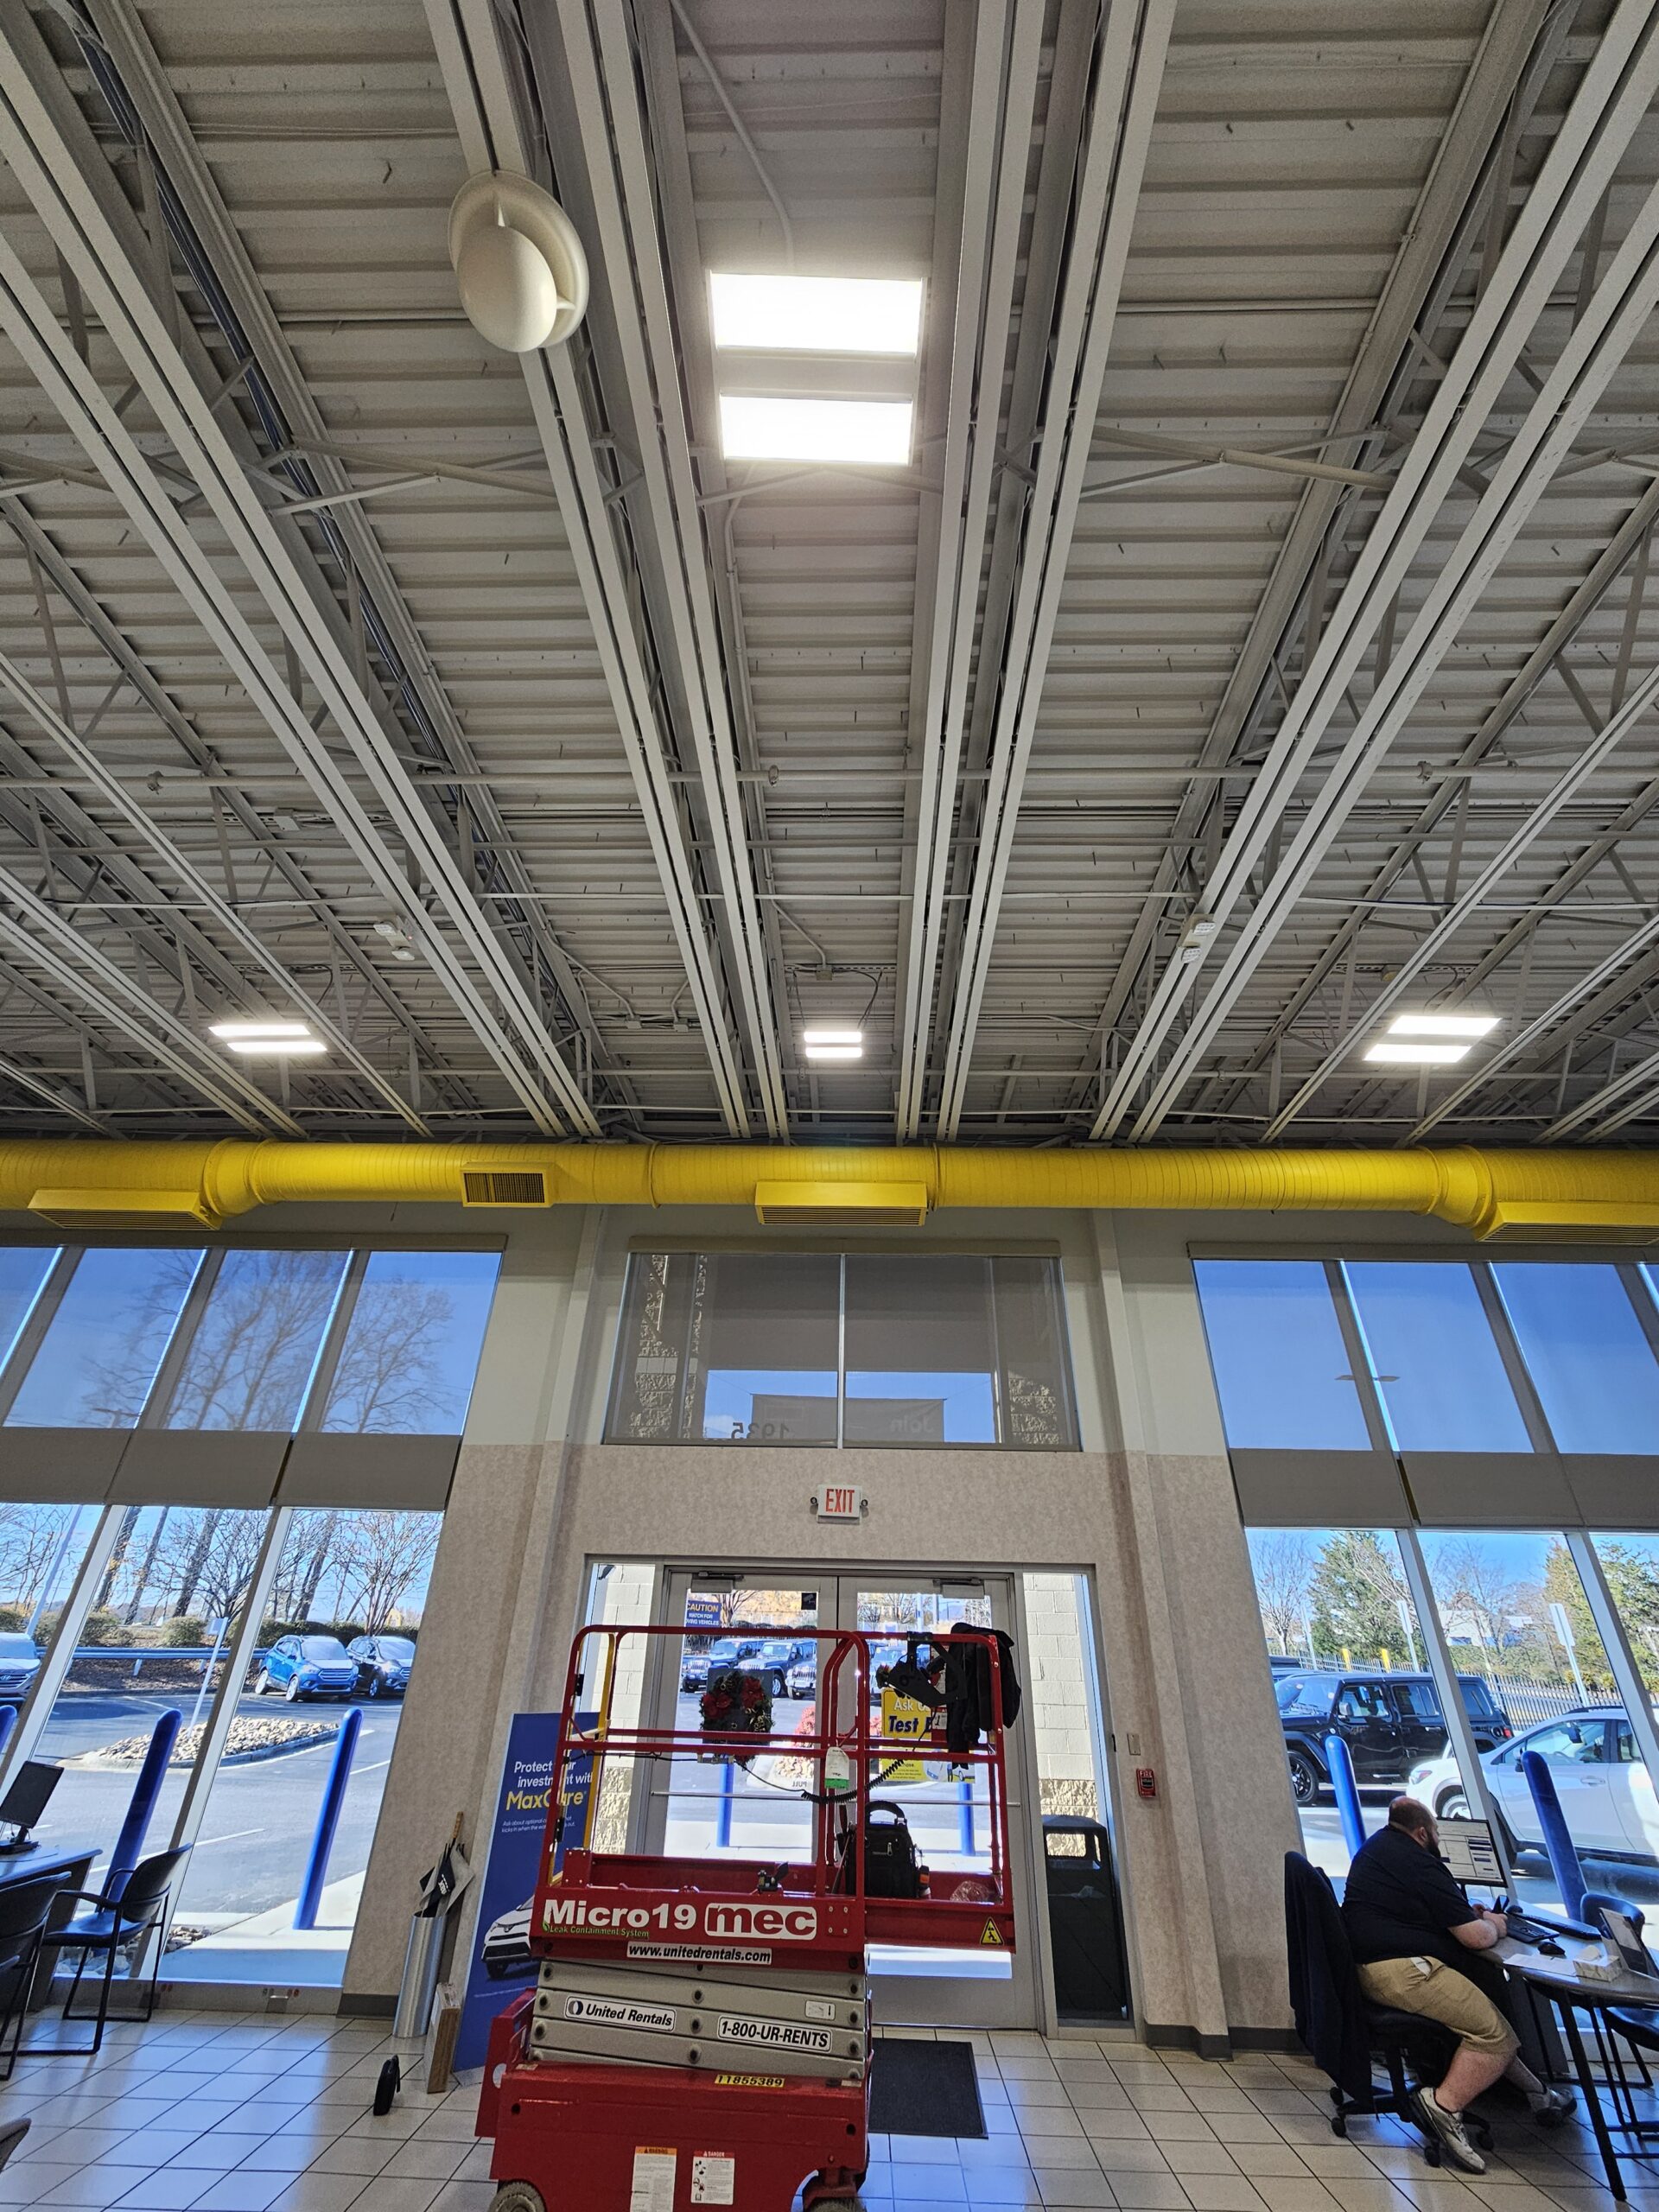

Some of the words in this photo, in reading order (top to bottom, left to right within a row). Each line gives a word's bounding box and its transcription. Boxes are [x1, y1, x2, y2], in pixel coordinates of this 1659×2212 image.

[825, 1488, 855, 1514] EXIT
[687, 1603, 719, 1612] CAUTION
[893, 1699, 913, 1712] Ask
[888, 1716, 919, 1733] Test
[513, 1760, 553, 1774] Protect
[543, 1899, 697, 1930] Micro19
[707, 1906, 816, 1936] mec
[550, 1925, 569, 1934] Leak
[570, 1926, 620, 1936] Containment
[621, 1929, 649, 1938] System
[628, 1945, 771, 1964] www.unitedrentals.com
[586, 2004, 626, 2019] United
[627, 2008, 673, 2026] Rentals
[721, 2020, 829, 2048] 1-800-UR-RENTS
[717, 2075, 783, 2087] 11855389
